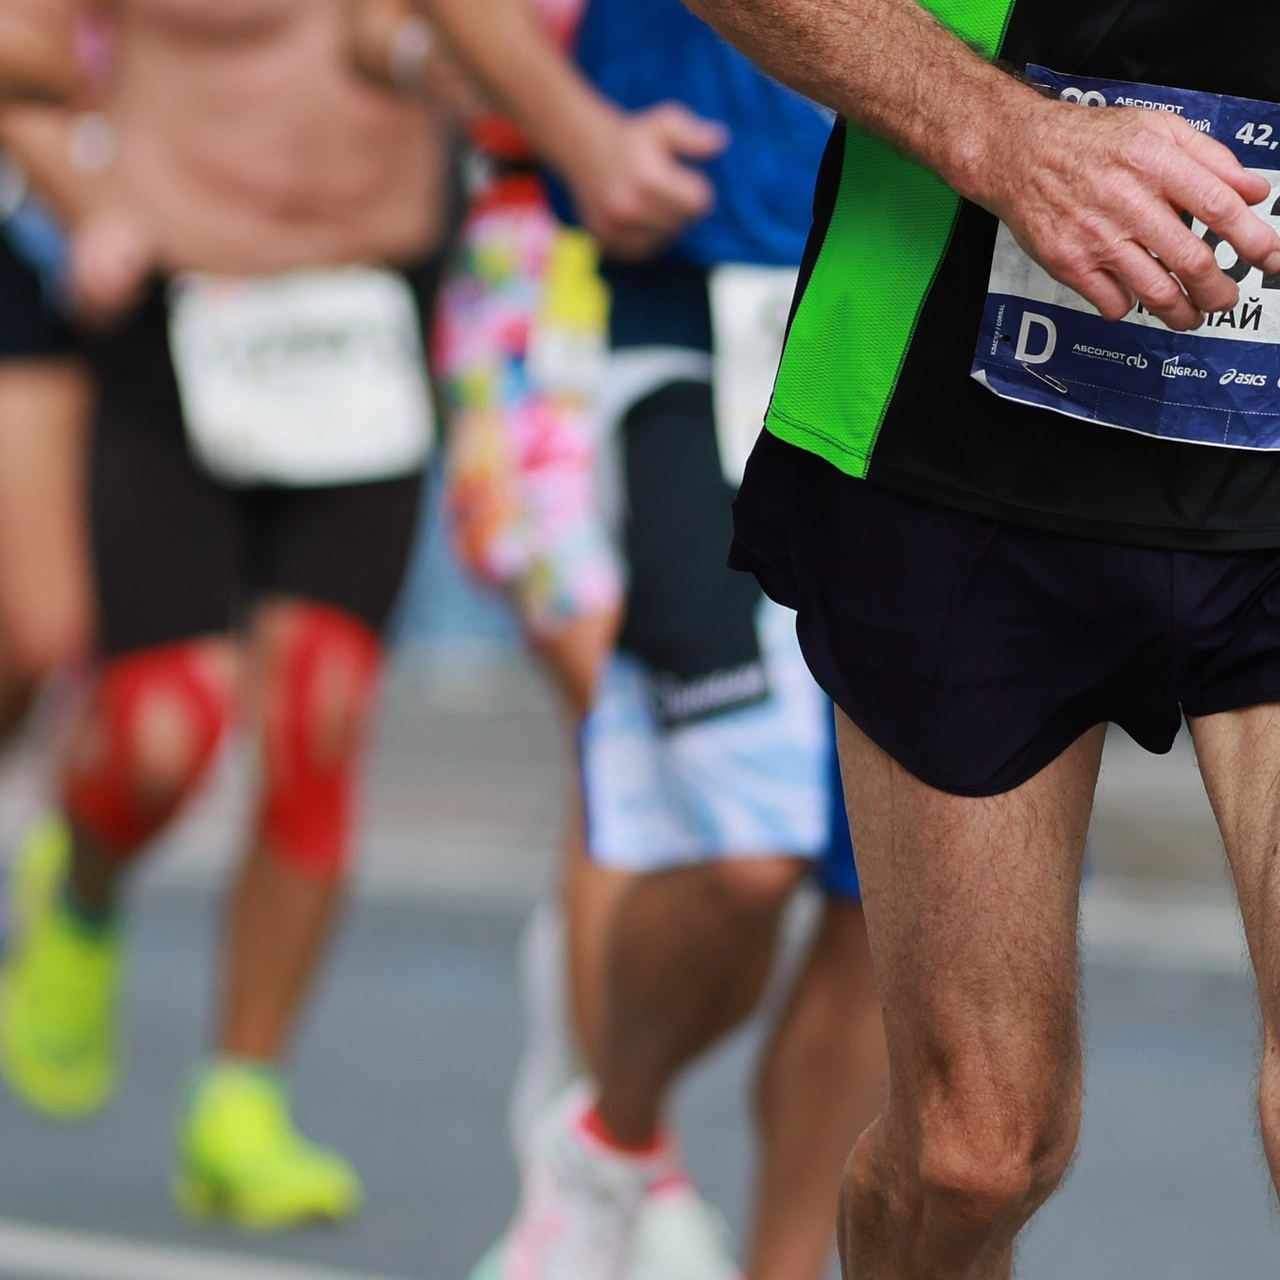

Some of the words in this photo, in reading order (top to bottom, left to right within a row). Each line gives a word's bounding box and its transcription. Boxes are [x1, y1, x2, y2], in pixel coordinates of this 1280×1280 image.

[1115, 96, 1184, 115] АБСОЛЮТ
[1014, 310, 1058, 365] D
[1072, 343, 1127, 361] АБСОЛЮТ
[1163, 363, 1208, 379] INGRAD
